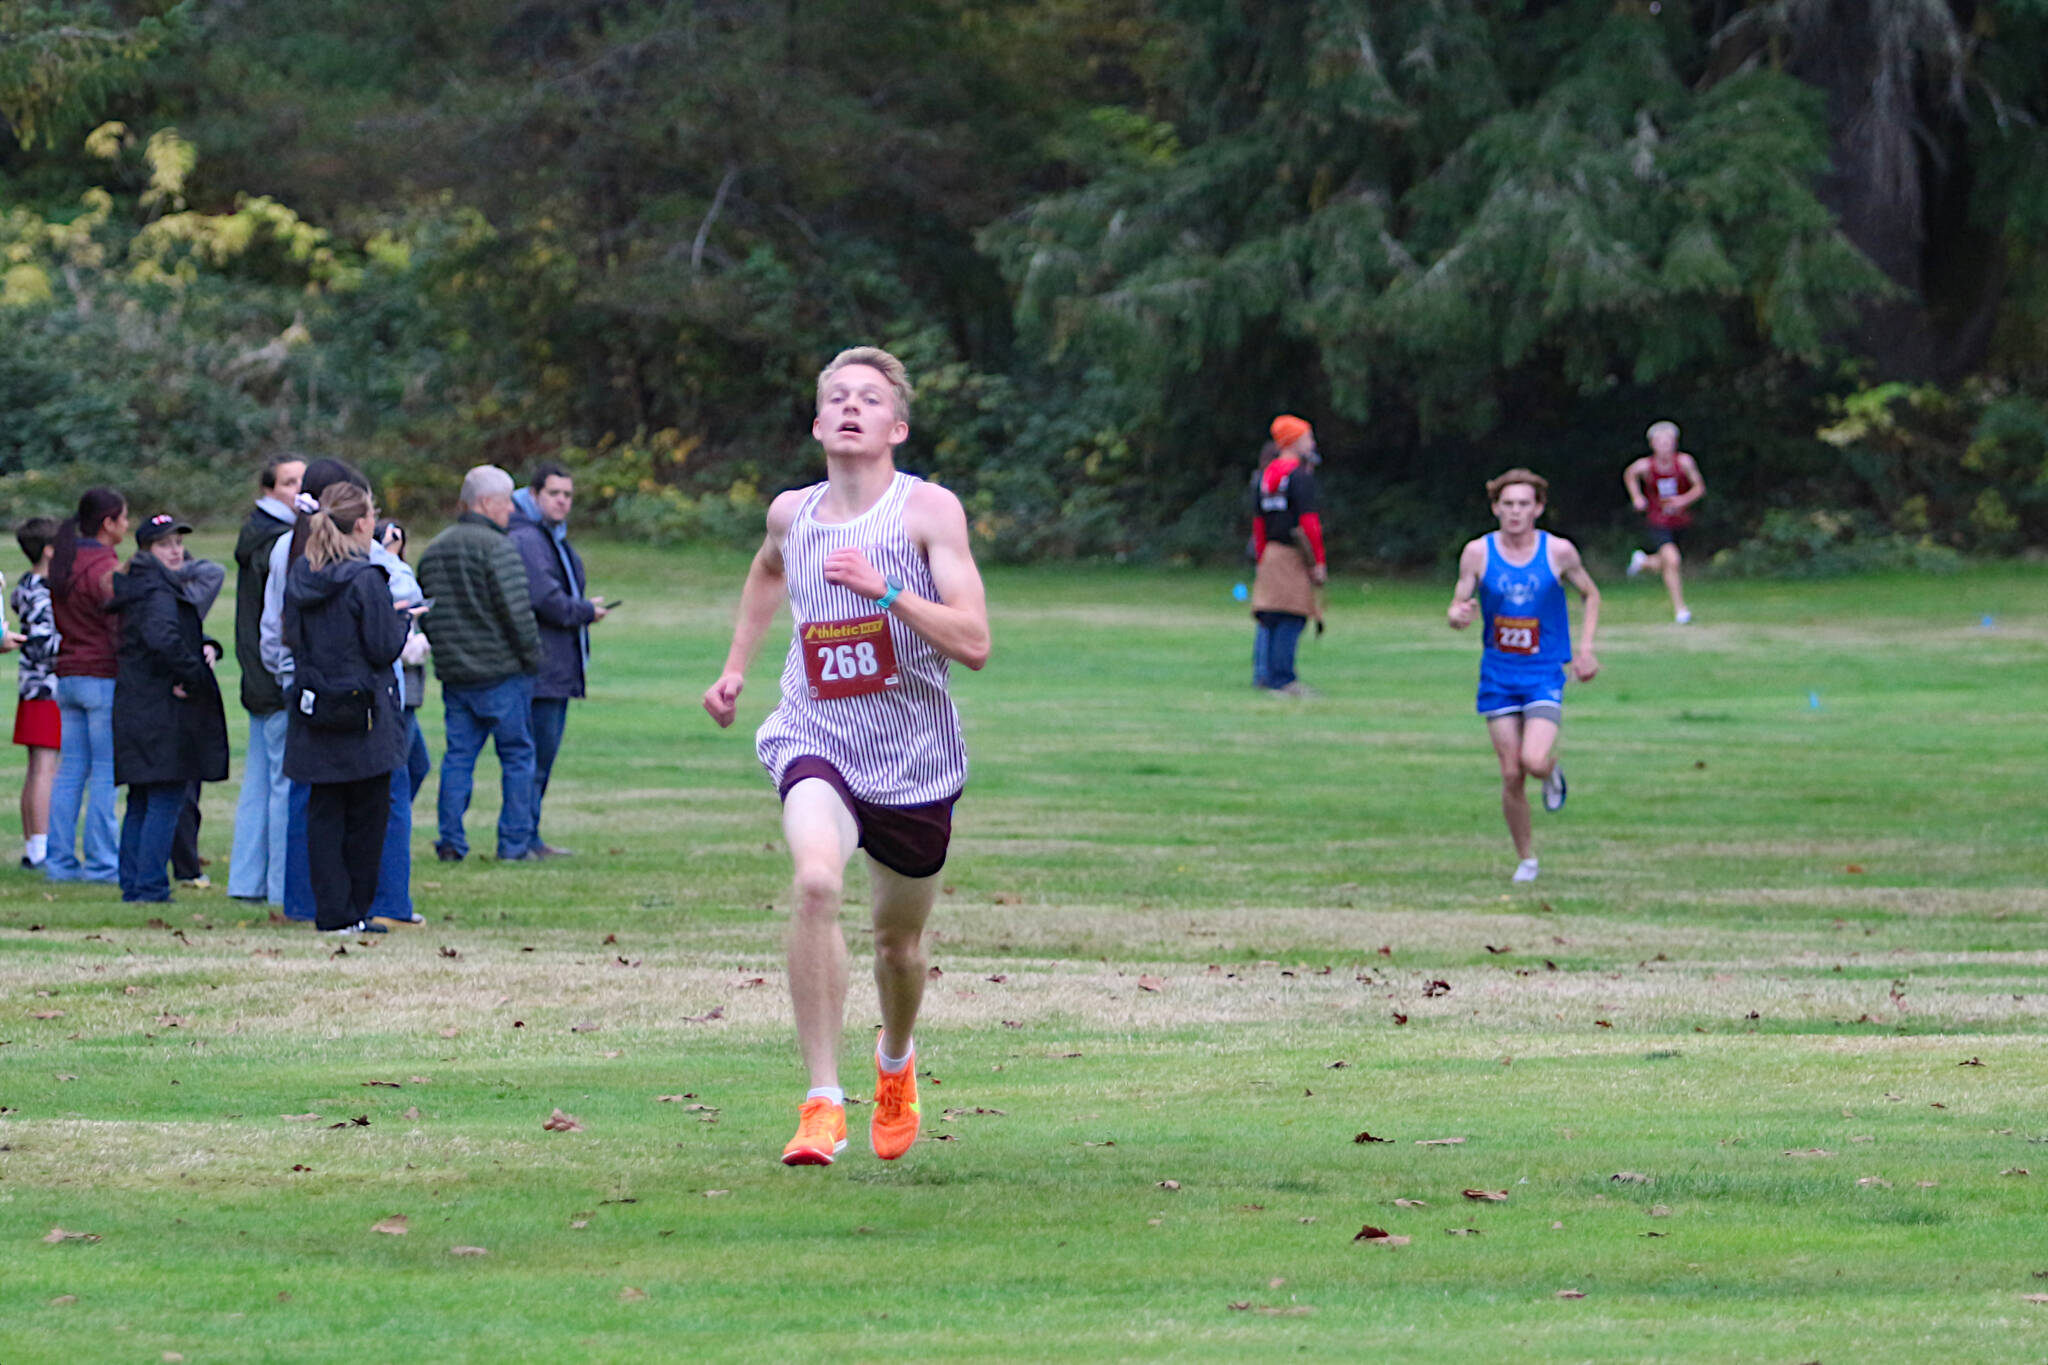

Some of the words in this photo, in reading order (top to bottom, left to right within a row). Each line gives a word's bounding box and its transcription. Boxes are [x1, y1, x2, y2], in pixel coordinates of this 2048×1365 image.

[805, 624, 859, 639] Athletic
[1500, 627, 1532, 648] 223
[818, 642, 878, 680] 268
